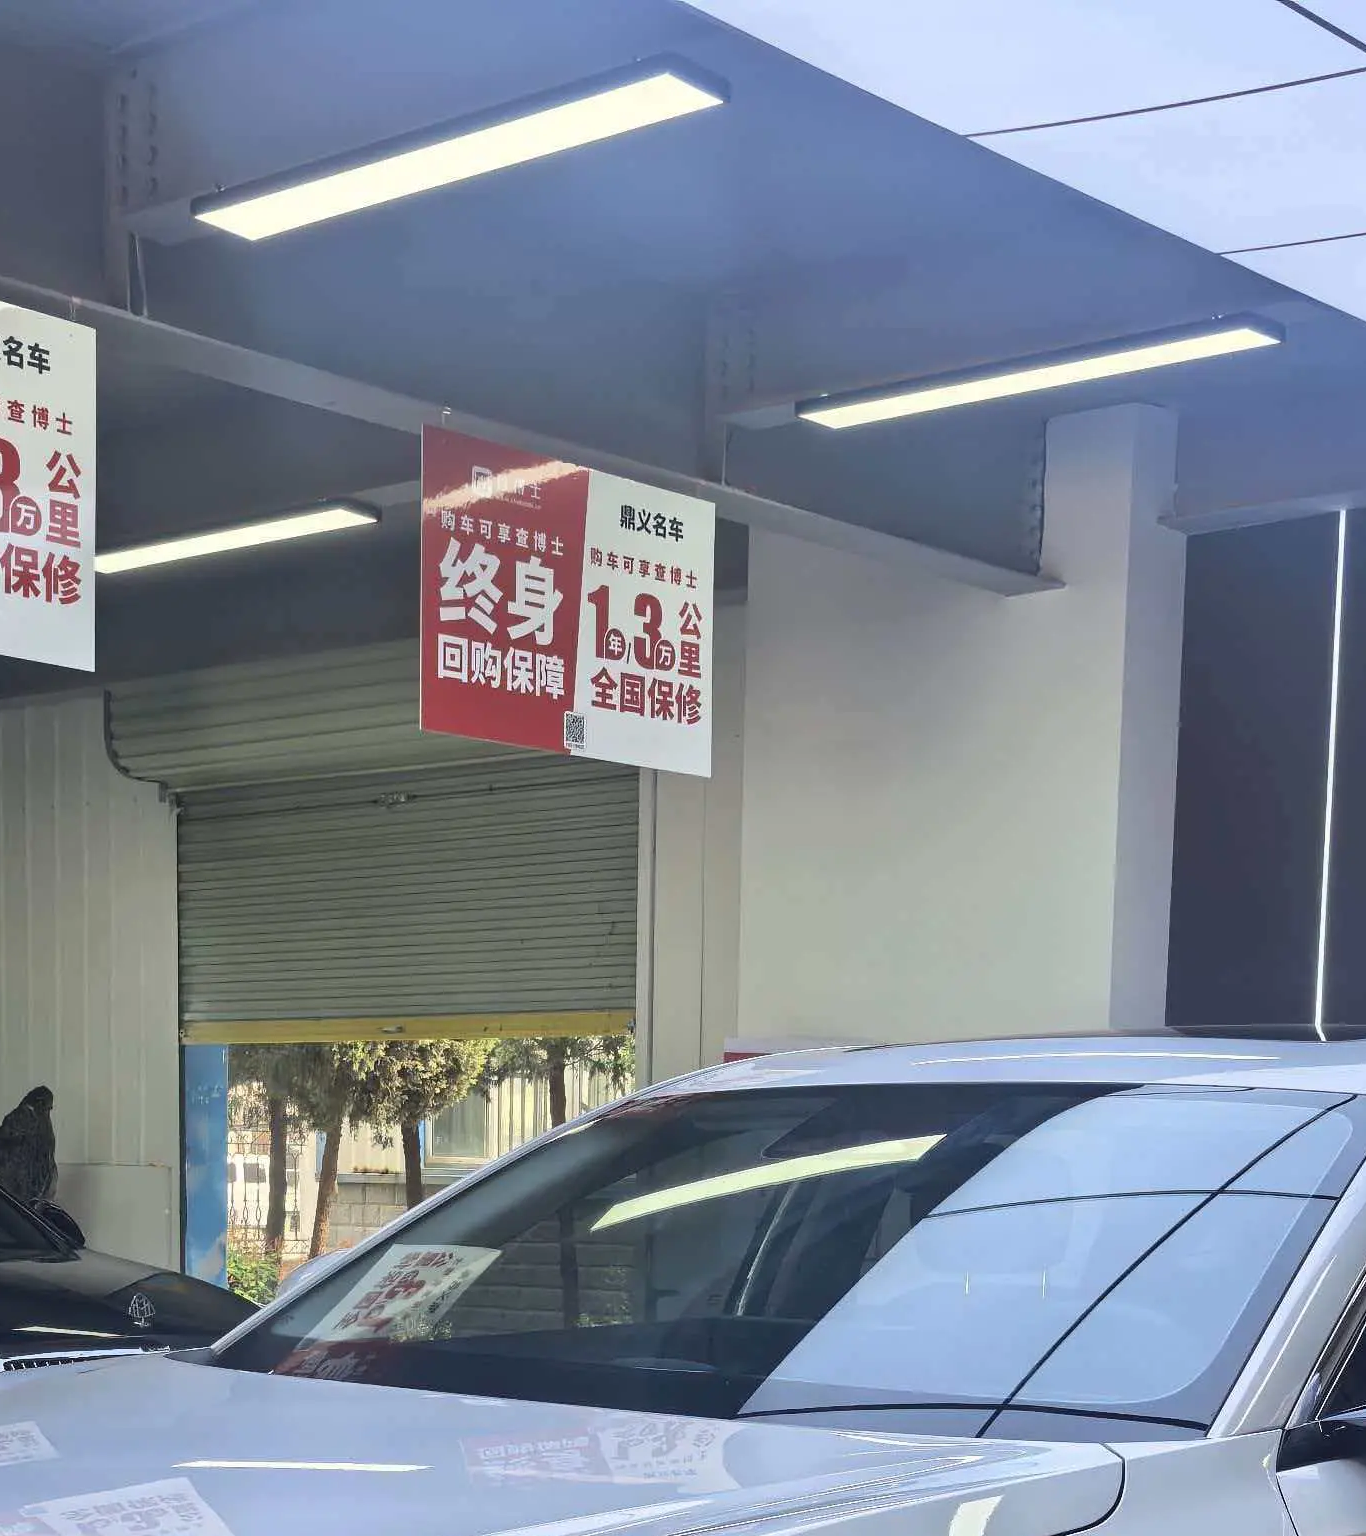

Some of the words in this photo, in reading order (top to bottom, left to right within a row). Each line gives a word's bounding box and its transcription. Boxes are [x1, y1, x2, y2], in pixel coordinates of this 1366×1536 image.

[441, 510, 564, 557] 购车可享查博士
[620, 504, 684, 543] 鼎义名车
[439, 537, 563, 646] 终身
[590, 547, 698, 590] 购车可享查博士
[437, 634, 565, 700] 回购保障
[591, 667, 702, 726] 全国保修
